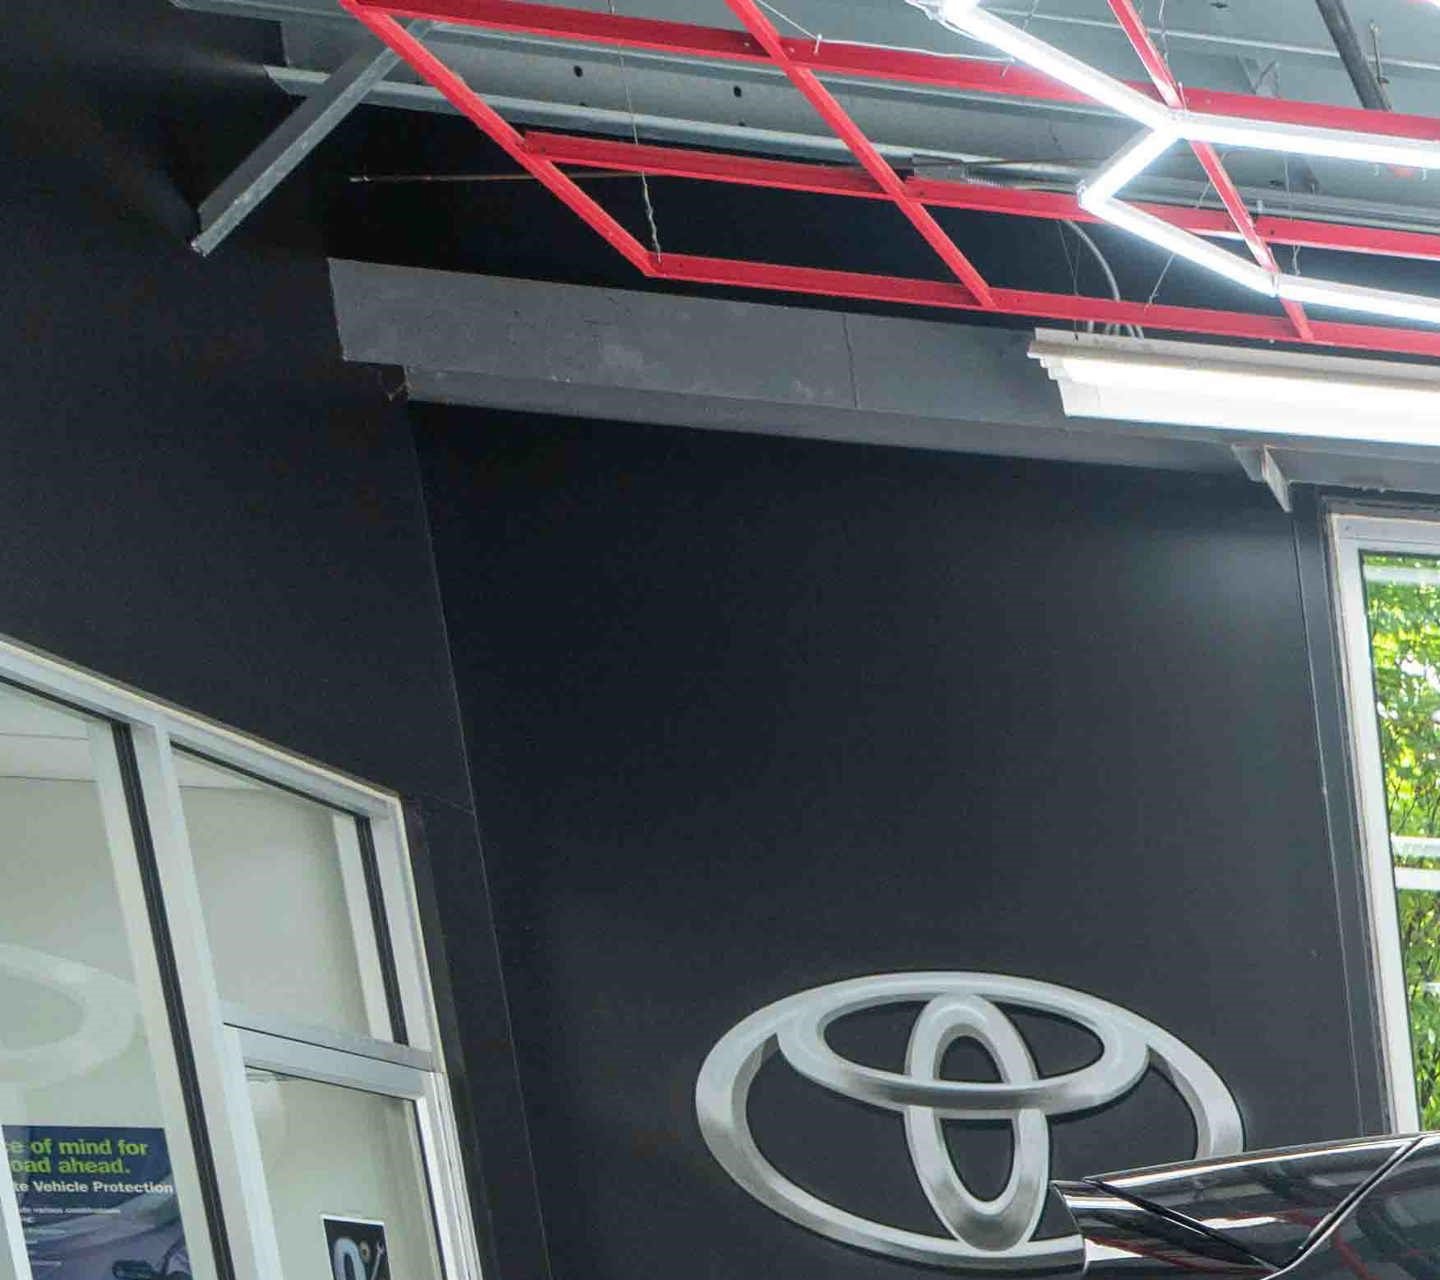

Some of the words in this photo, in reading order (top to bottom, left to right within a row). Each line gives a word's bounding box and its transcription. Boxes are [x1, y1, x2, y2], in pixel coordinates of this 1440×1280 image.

[31, 1138, 53, 1154] of
[58, 1138, 113, 1155] mind
[118, 1139, 148, 1156] for
[11, 1158, 51, 1173] oad
[58, 1158, 131, 1174] ahead.
[34, 1181, 88, 1193] Vehicle
[93, 1182, 174, 1194] Protection
